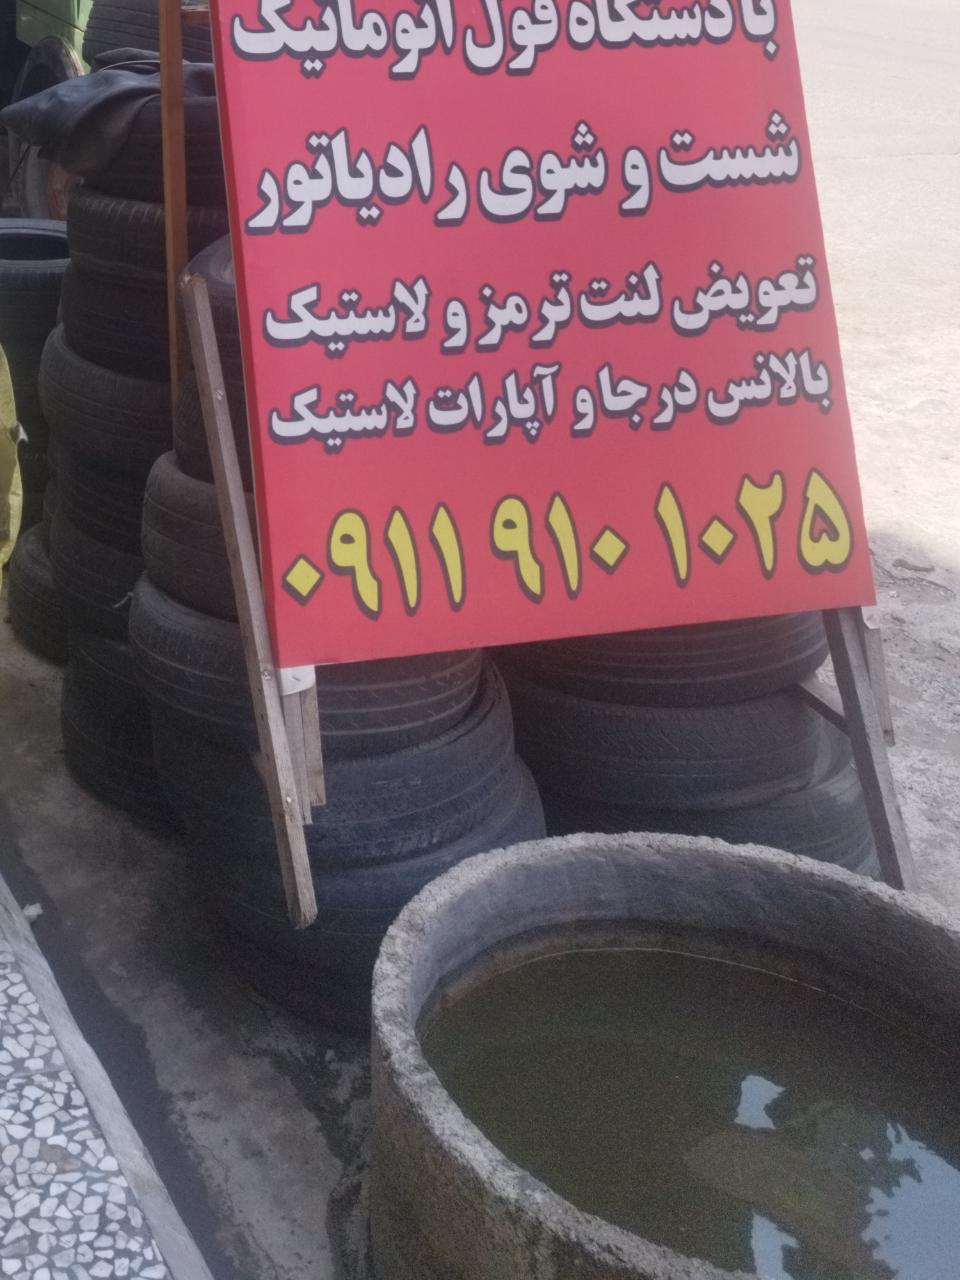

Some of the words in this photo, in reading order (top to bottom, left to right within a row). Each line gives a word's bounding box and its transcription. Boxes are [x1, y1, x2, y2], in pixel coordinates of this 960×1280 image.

[246, 126, 470, 235] رادیاتور
[477, 120, 608, 223] شوی
[619, 140, 653, 217] و
[657, 111, 803, 192] شست
[263, 275, 431, 357] لاستیک
[441, 297, 471, 355] و
[475, 270, 575, 352] ترمز
[577, 261, 663, 329] لنت
[670, 253, 822, 337] تعویض
[268, 378, 419, 453] لاستیک
[426, 362, 561, 444] آپارات
[704, 348, 836, 425] بالانس
